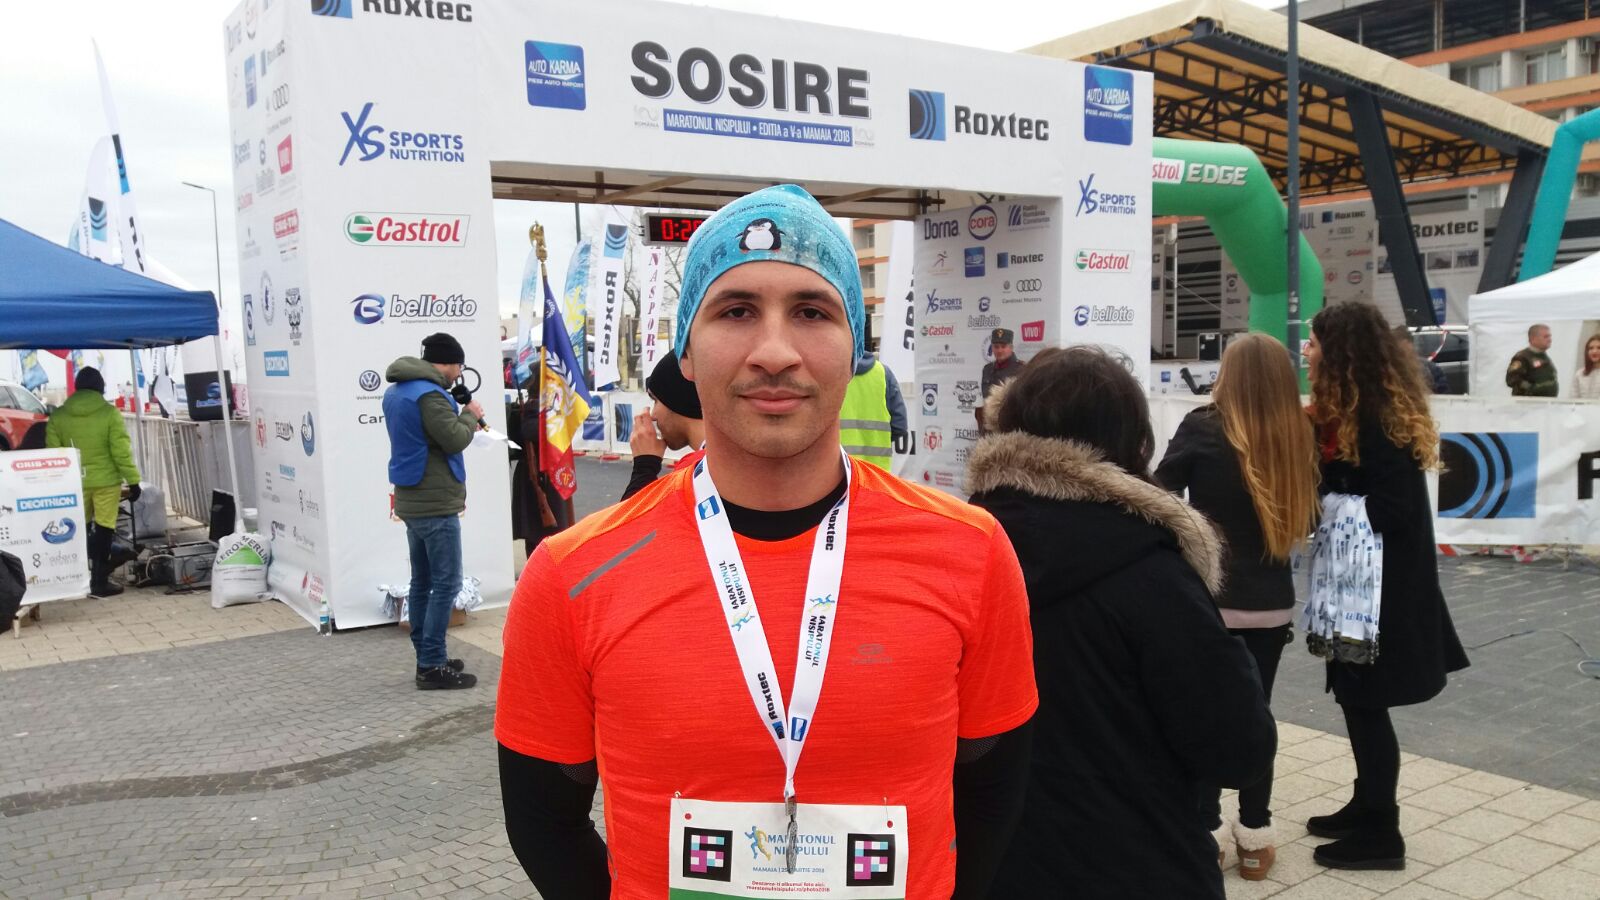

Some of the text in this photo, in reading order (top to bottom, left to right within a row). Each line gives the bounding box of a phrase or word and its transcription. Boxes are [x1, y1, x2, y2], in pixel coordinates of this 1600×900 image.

[528, 59, 581, 74] AUTO KARMA
[630, 40, 872, 120] SOSIRE
[1086, 87, 1131, 105] AUTO KARMA
[666, 112, 714, 131] MARATONUL
[715, 117, 751, 134] NISIPULUI
[759, 122, 782, 137] EDITIA
[783, 127, 789, 138] a
[803, 125, 832, 141] MAMAIA
[833, 129, 850, 143] 2018
[954, 105, 1050, 141] Roxtec
[389, 131, 464, 150] SPORTS
[389, 149, 465, 163] NUTRITION
[1186, 162, 1249, 186] EDGE
[1099, 193, 1136, 206] SPORTS
[1099, 205, 1136, 215] NUTRITION
[375, 216, 462, 243] Castrol
[923, 217, 959, 240] Dorna
[969, 215, 995, 230] cora
[1413, 220, 1479, 238] Roxtec
[1010, 253, 1044, 264] Roxtec
[1088, 251, 1130, 270] Castrol
[389, 294, 478, 318] bellotto
[646, 246, 662, 363] NASPORT
[940, 297, 962, 306] SPORTS
[967, 314, 1001, 328] bellotto
[1091, 304, 1135, 322] bellotto
[928, 325, 954, 336] Castrol
[20, 496, 75, 510] DECATHLON
[825, 508, 840, 551] Roxtec
[728, 563, 749, 606] NISIPULUI
[804, 615, 818, 661] NISIPULUI
[757, 671, 778, 721] Roxtec
[767, 834, 836, 845] MATONUL
[774, 846, 829, 856] NIPULUI
